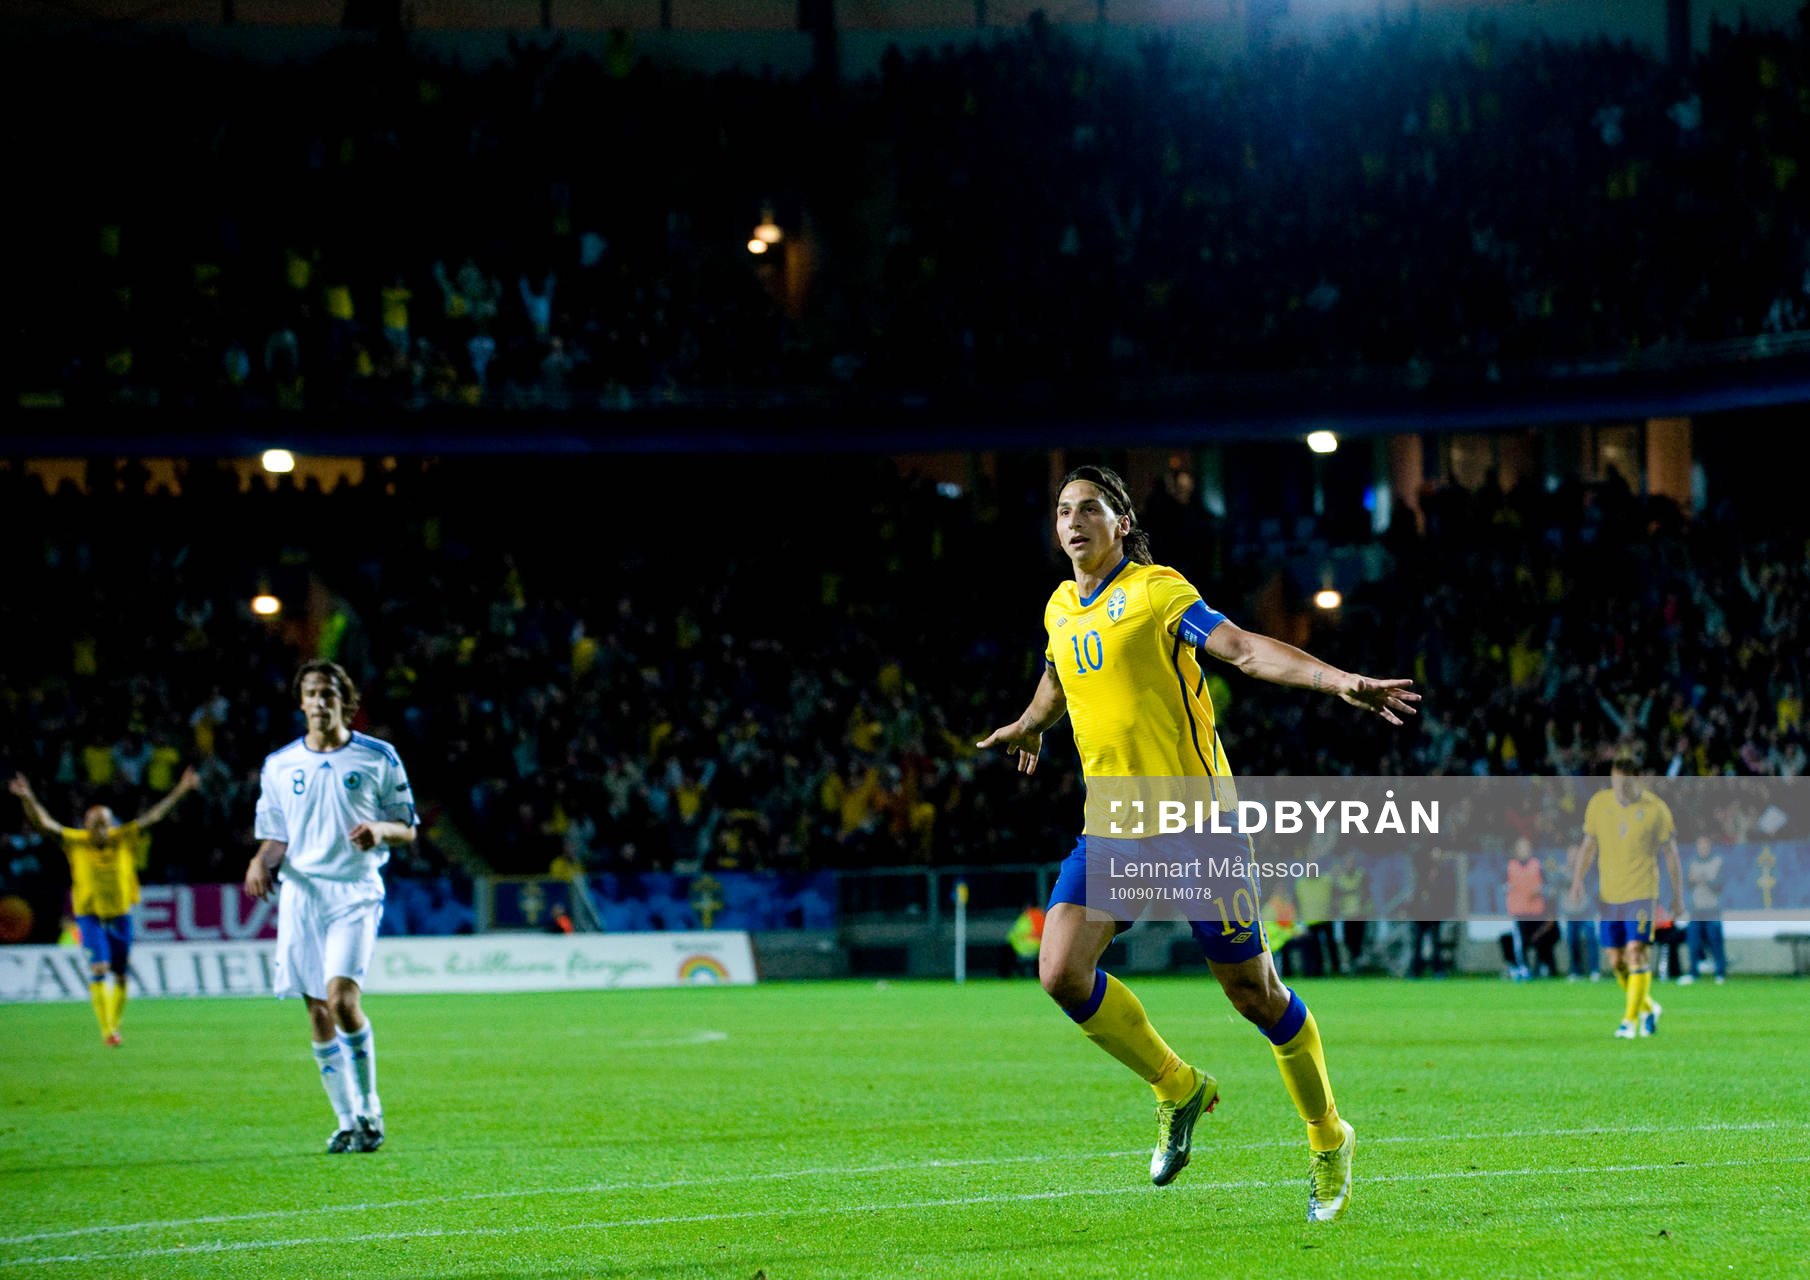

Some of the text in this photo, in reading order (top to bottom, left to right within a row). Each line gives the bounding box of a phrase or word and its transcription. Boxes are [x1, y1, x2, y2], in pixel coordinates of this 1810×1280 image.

[1071, 629, 1104, 675] 10
[292, 768, 305, 796] 8
[1212, 887, 1255, 936] 10
